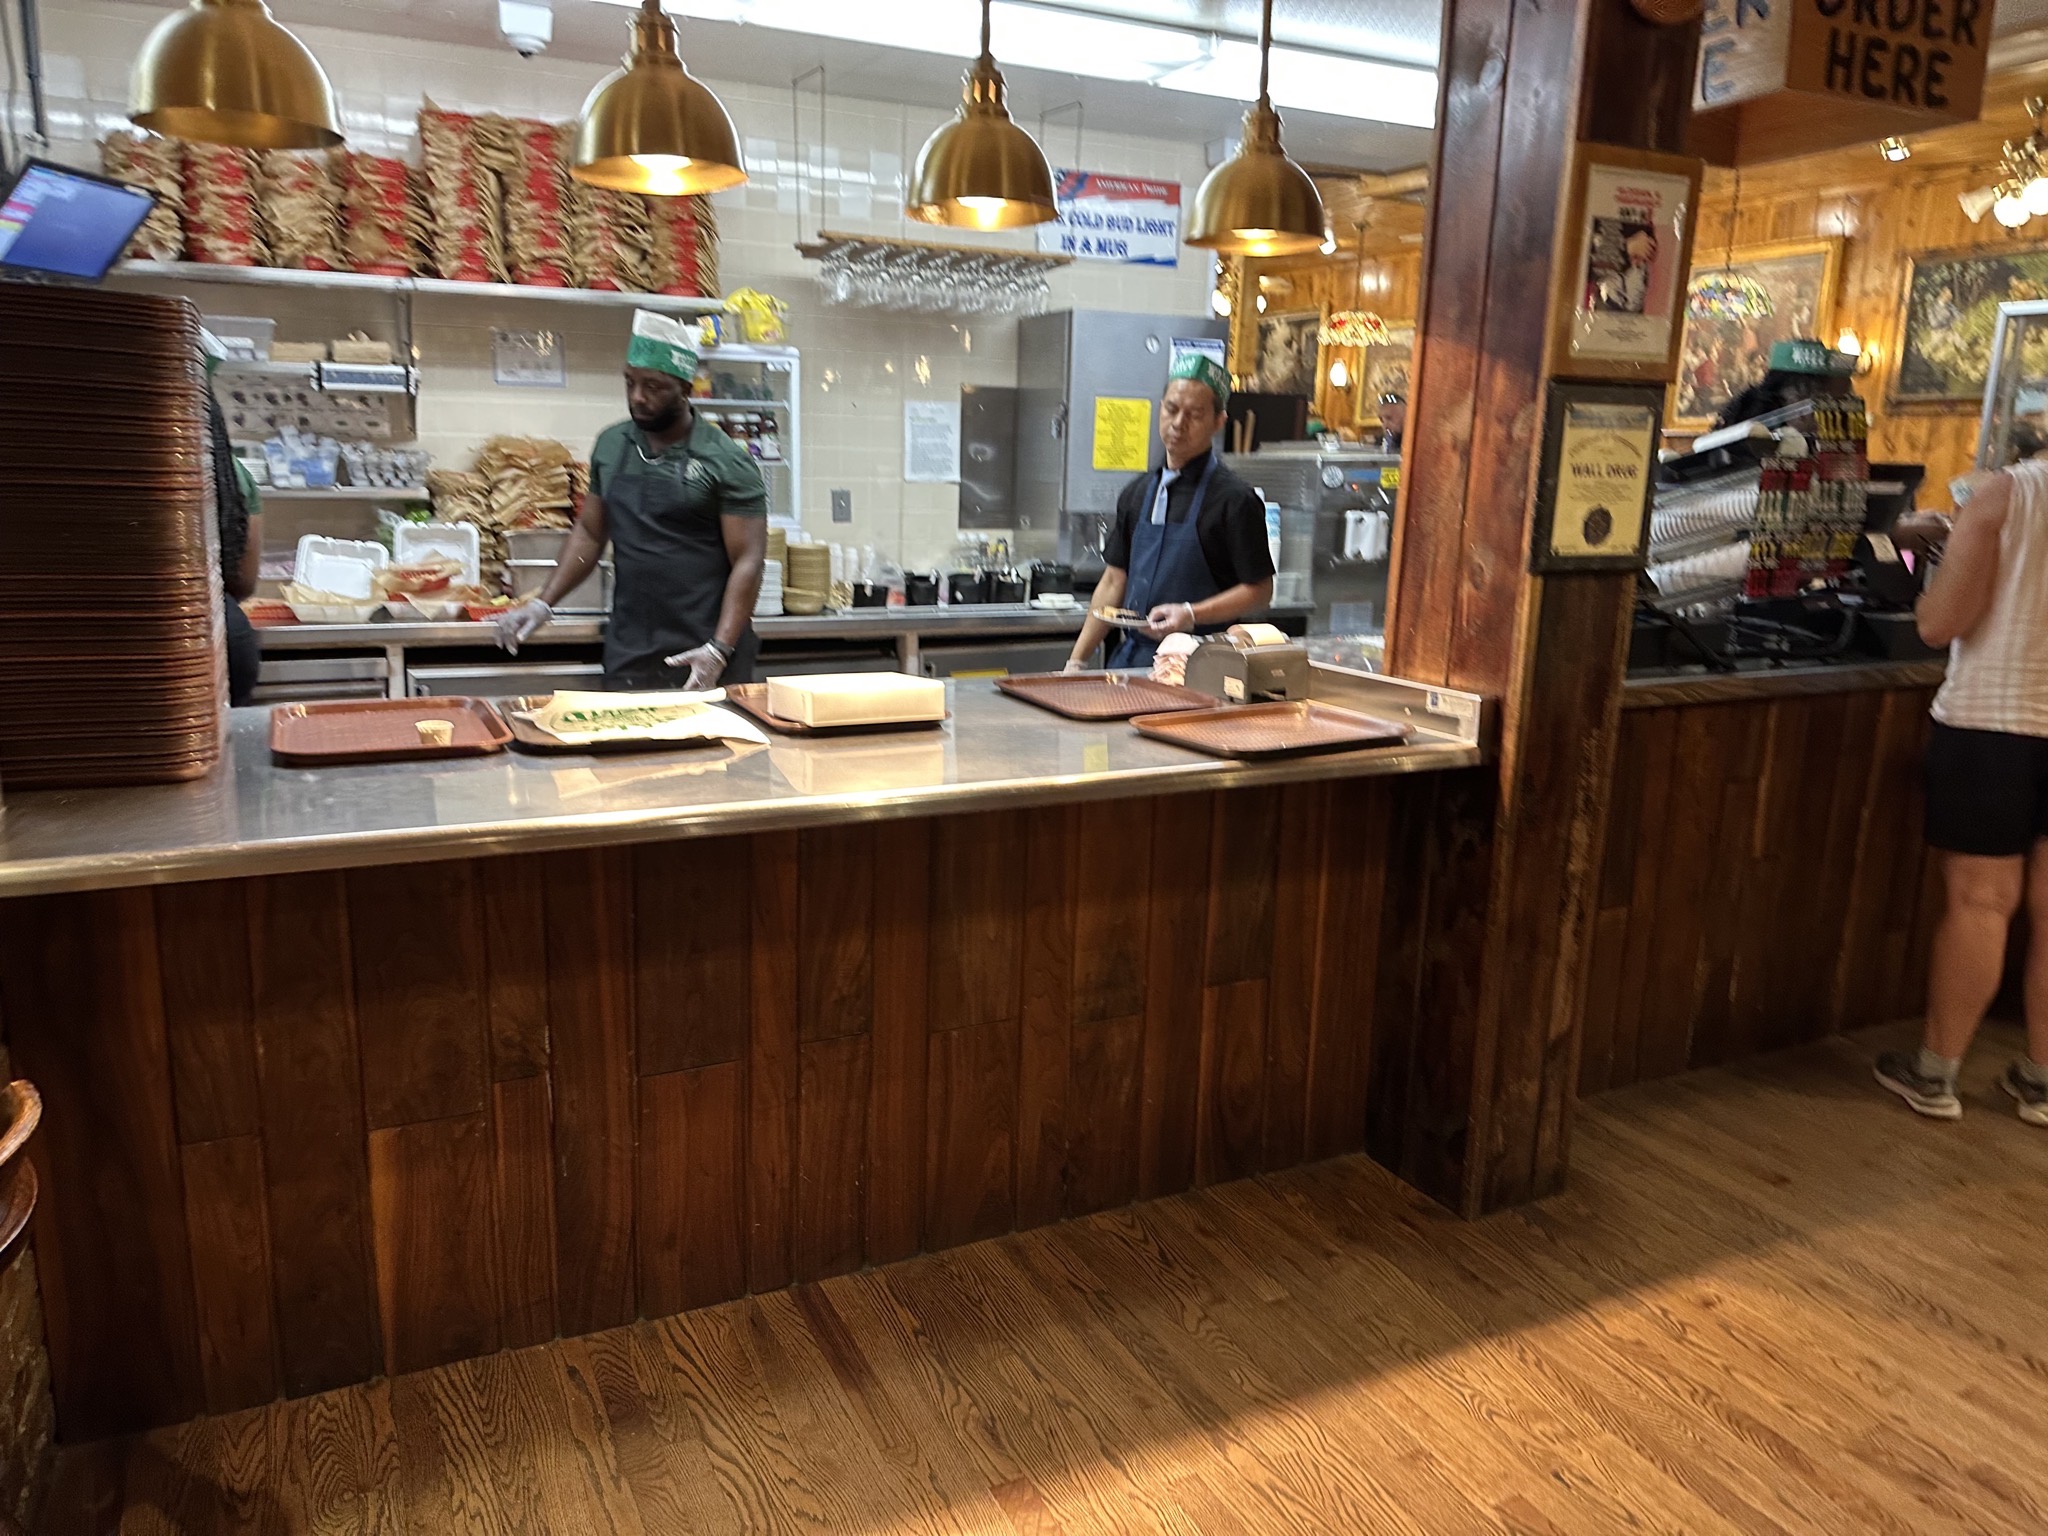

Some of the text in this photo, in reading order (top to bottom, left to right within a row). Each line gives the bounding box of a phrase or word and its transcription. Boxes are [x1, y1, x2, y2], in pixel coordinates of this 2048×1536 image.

[1825, 26, 1952, 109] HERE
[1067, 210, 1104, 231] COLD
[1105, 213, 1134, 234] BUD
[1135, 216, 1176, 238] LIGHT
[1060, 233, 1129, 257] IN A MUG
[1570, 461, 1640, 481] WALL DRUG
